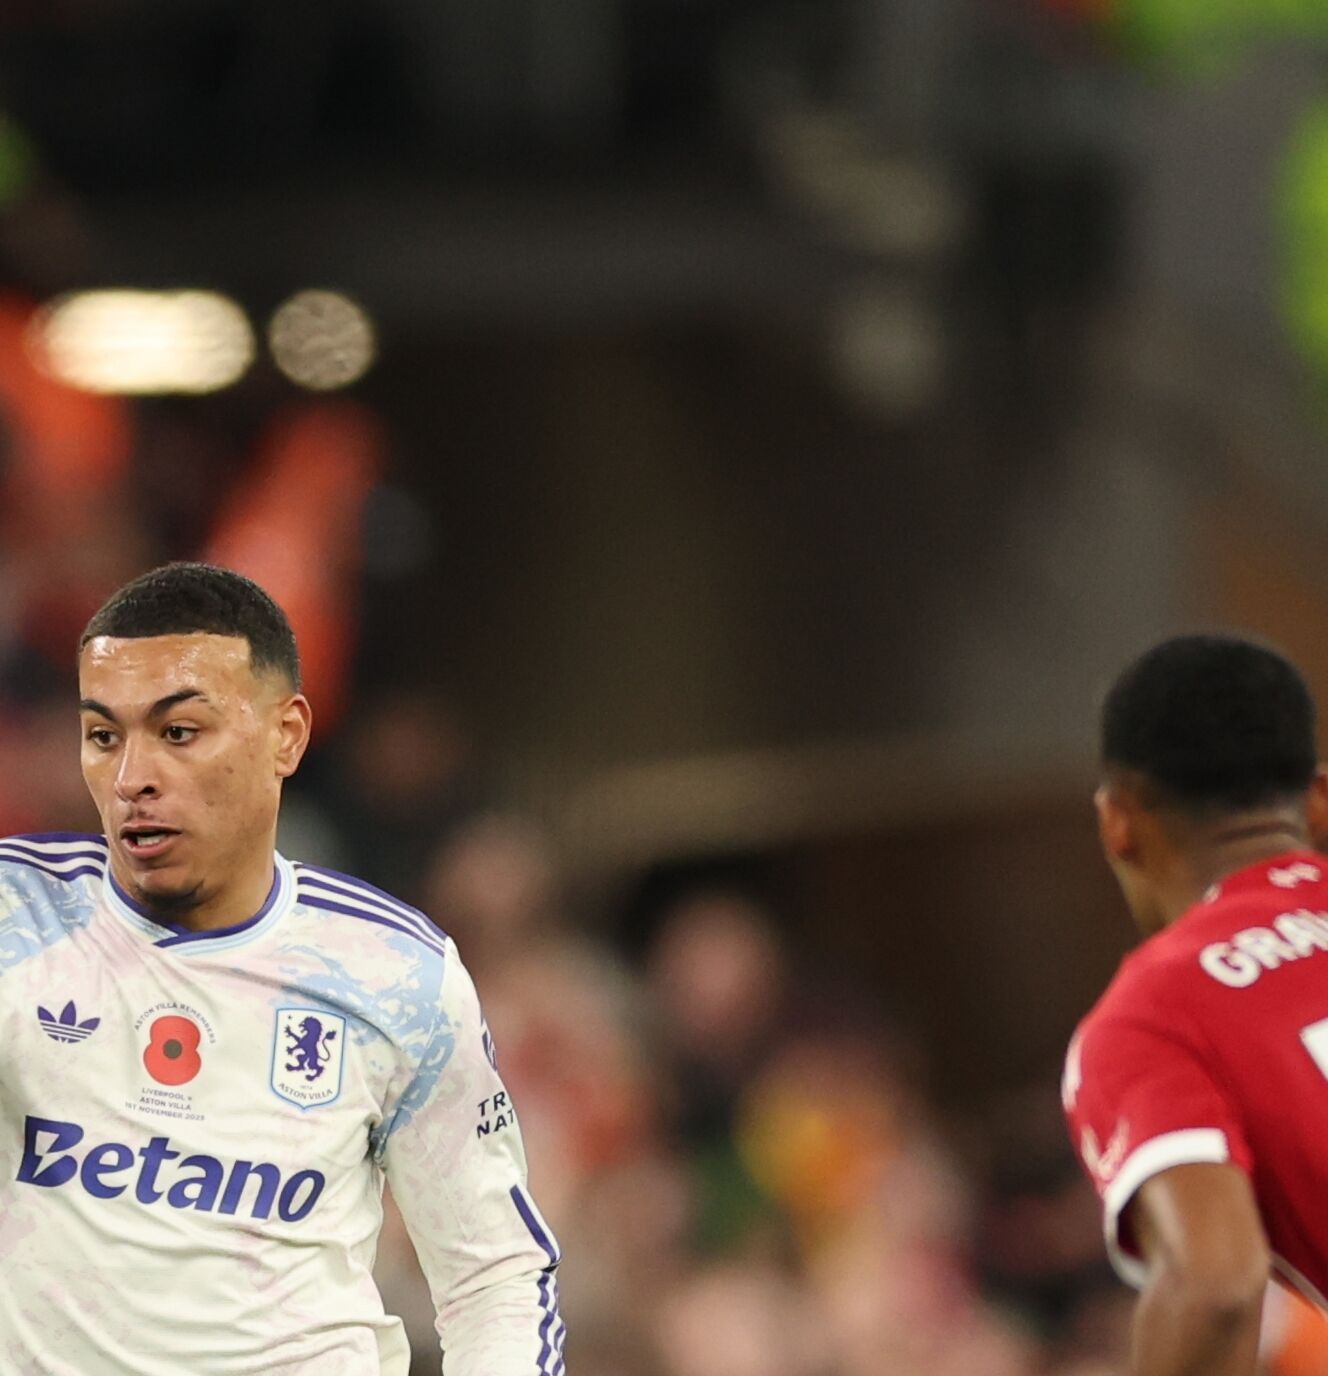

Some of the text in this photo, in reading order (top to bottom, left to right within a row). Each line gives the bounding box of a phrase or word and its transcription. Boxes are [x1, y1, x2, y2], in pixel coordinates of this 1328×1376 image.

[134, 1006, 155, 1030] ASTON
[155, 1002, 178, 1011] VILLA
[141, 1087, 185, 1101] LIVERPOOL
[278, 1082, 333, 1100] ASTON VILLA
[139, 1096, 192, 1111] ASTON VILLA
[139, 1106, 183, 1119] NOVEMBER
[16, 1115, 326, 1222] Betano
